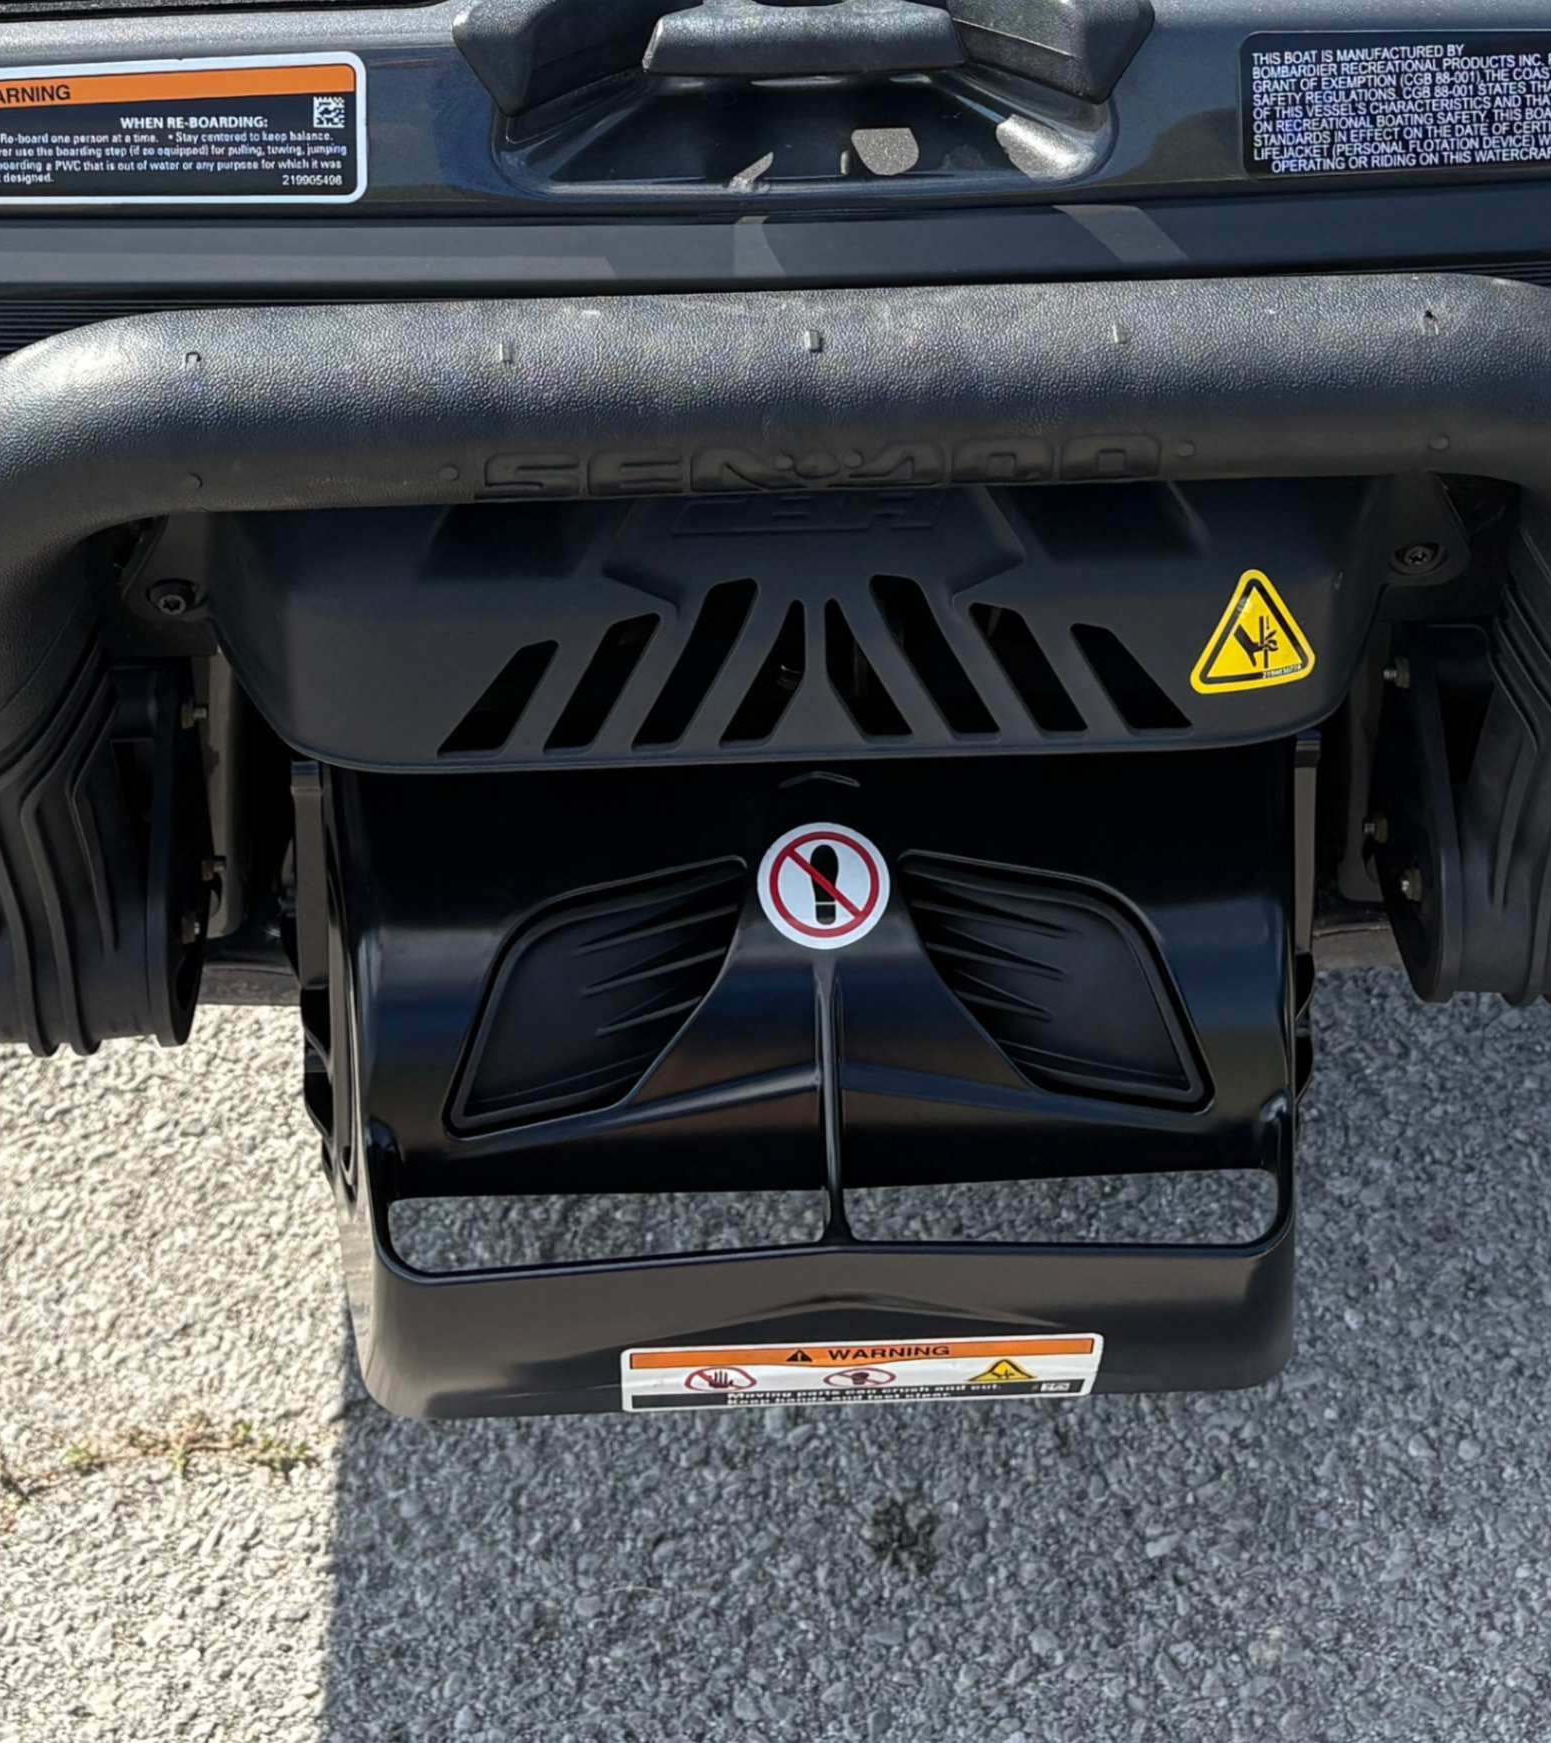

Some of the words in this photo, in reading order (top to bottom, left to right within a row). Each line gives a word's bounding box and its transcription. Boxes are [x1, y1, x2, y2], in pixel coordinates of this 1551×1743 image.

[1253, 52, 1281, 64] THIS
[1283, 51, 1317, 63] BOAT
[1321, 50, 1333, 62] IS
[1336, 46, 1443, 61] MANUFACTURED
[1446, 45, 1463, 57] BY
[1252, 64, 1337, 79] BOMBARDIER
[1340, 59, 1438, 75] RECREATIONAL
[1442, 55, 1515, 70] PRODUCTS
[1518, 54, 1543, 66] INC.
[1252, 79, 1296, 93] GRANT
[1299, 78, 1317, 90] OF
[1320, 74, 1396, 89] EXEMPTION
[1485, 69, 1509, 82] THE
[1252, 93, 1302, 106] SAFETY
[1304, 88, 1399, 103] REGULATIONS.
[1402, 86, 1430, 99] CGB
[1477, 82, 1526, 95] STATES
[1252, 108, 1269, 119] OF
[1275, 106, 1303, 118] THIS
[1369, 97, 1491, 114] CHARACTERISTICS
[1494, 96, 1521, 108] AND
[120, 117, 163, 129] WHEN
[166, 116, 267, 128] RE-BOARDING:
[1253, 121, 1273, 133] ON
[1275, 116, 1372, 132] RECREATIONAL
[1376, 113, 1433, 127] BOATING
[1436, 111, 1488, 124] SAFETY.
[1494, 109, 1522, 121] THIS
[1253, 132, 1330, 147] STANDARDS
[1334, 131, 1347, 143] IN
[1349, 129, 1399, 142] EFFECT
[1402, 127, 1423, 139] ON
[1427, 126, 1451, 138] THE
[1454, 124, 1488, 137] DATE
[1491, 123, 1508, 135] OF
[1332, 142, 1404, 157] (PERSONAL
[1408, 138, 1479, 153] FLOTATION
[1482, 135, 1535, 149] DEVICE)
[1271, 158, 1345, 173] OPERATING
[1348, 157, 1368, 169] OR
[1370, 155, 1416, 168] RIDING
[1419, 154, 1439, 166] ON
[1443, 152, 1471, 164] THIS
[828, 1345, 950, 1361] WARNING
